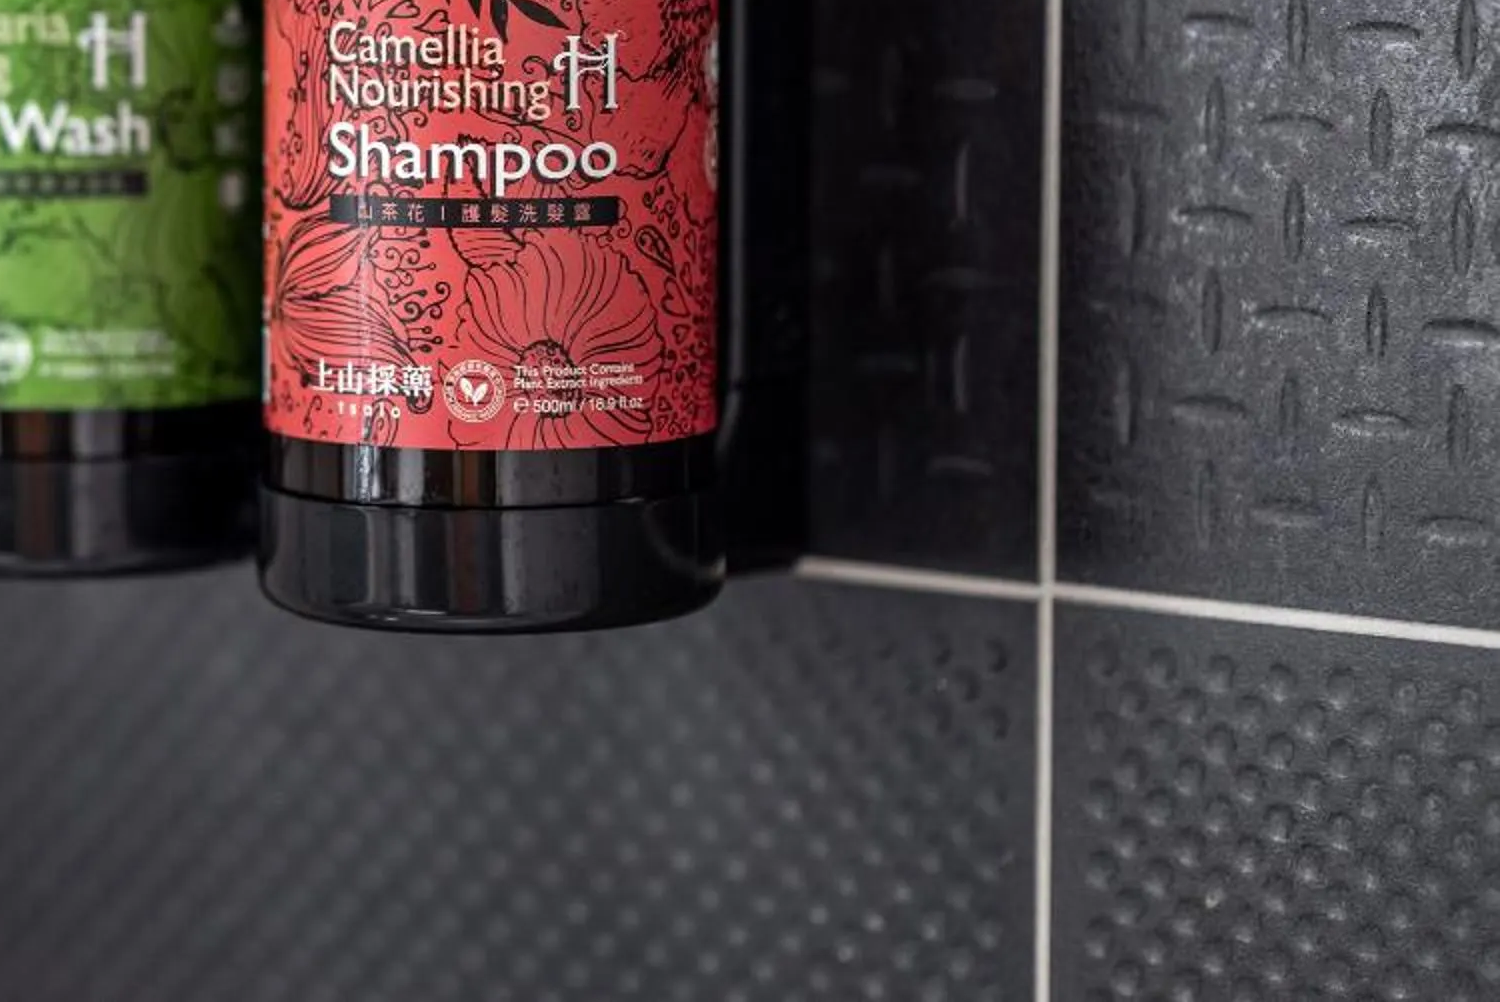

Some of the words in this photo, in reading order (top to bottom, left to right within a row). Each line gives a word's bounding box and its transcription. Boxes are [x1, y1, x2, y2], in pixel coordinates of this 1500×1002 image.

[328, 20, 505, 66] Camellia
[328, 65, 551, 121] Nourishing
[553, 31, 621, 110] H
[328, 121, 618, 197] Shampoo
[312, 357, 434, 398] 上山採藥
[513, 365, 539, 377] This
[543, 364, 587, 377] Product
[547, 376, 587, 389] Extract
